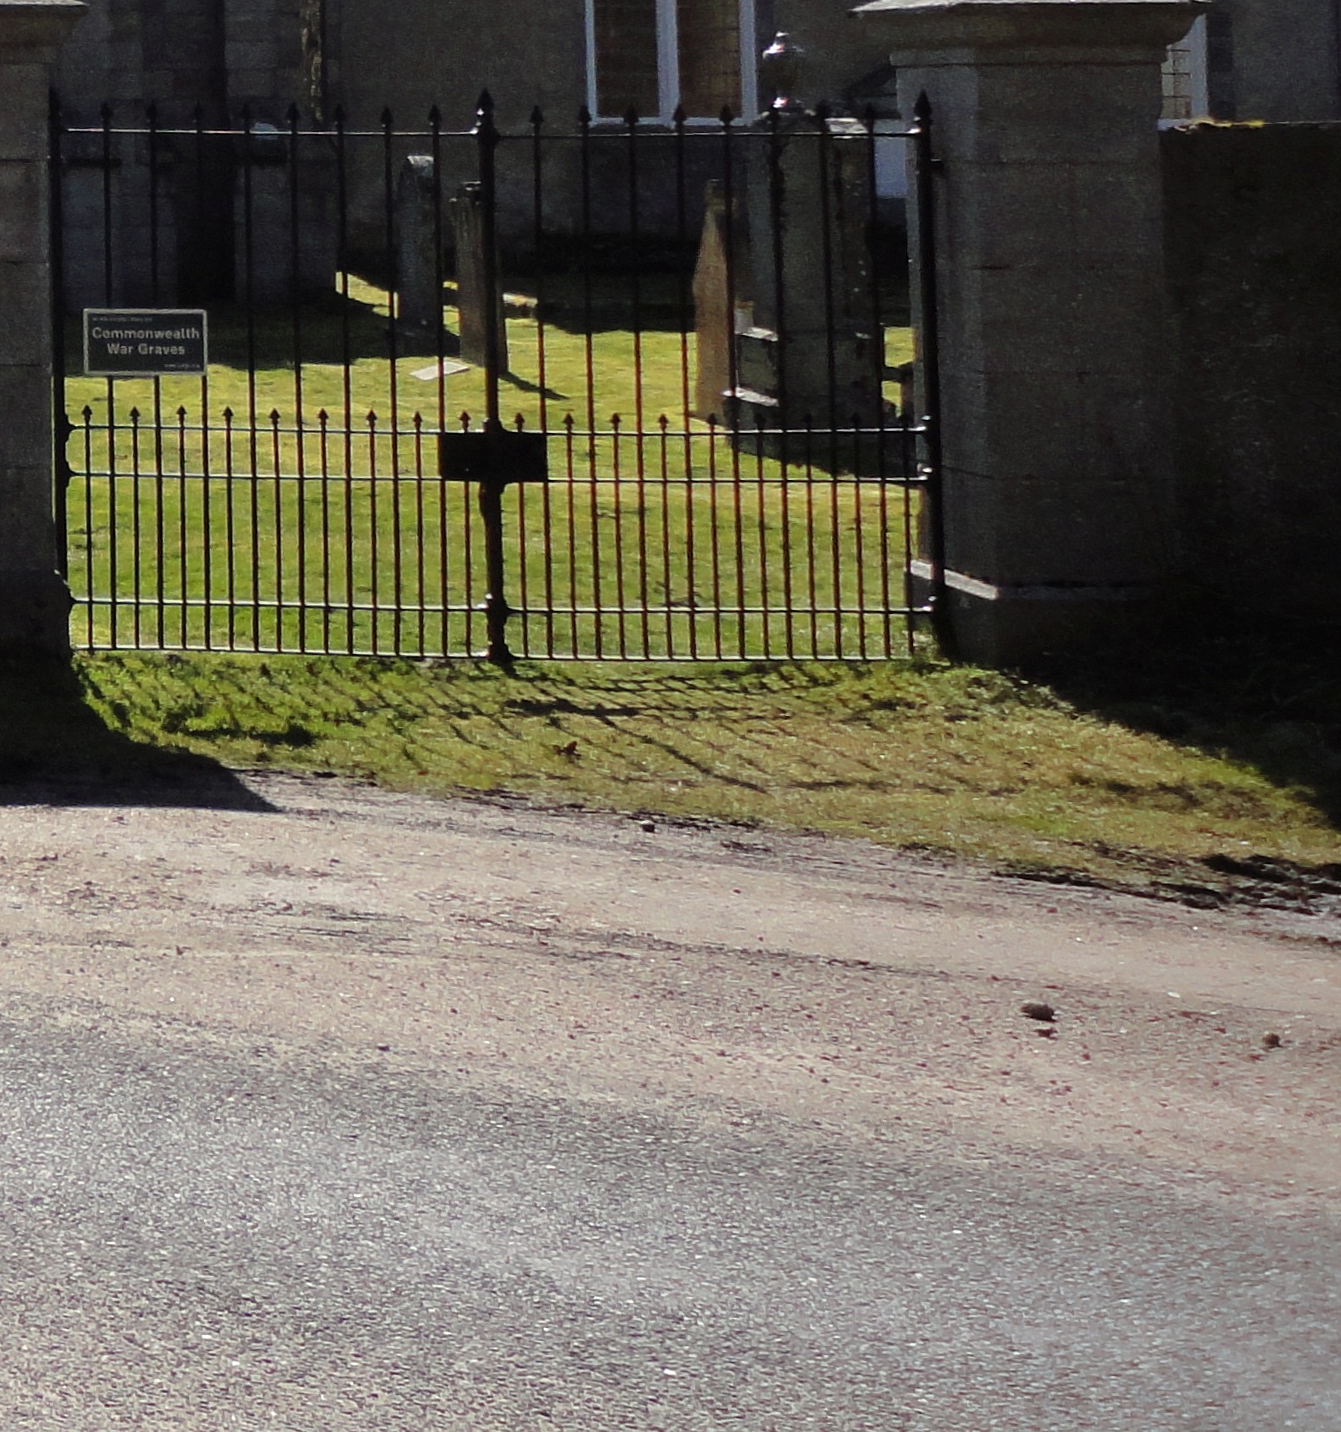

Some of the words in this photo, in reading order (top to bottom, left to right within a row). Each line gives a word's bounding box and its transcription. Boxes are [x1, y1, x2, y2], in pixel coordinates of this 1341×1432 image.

[91, 326, 200, 340] Commonwealth
[106, 342, 133, 355] War
[137, 342, 186, 355] Graves
